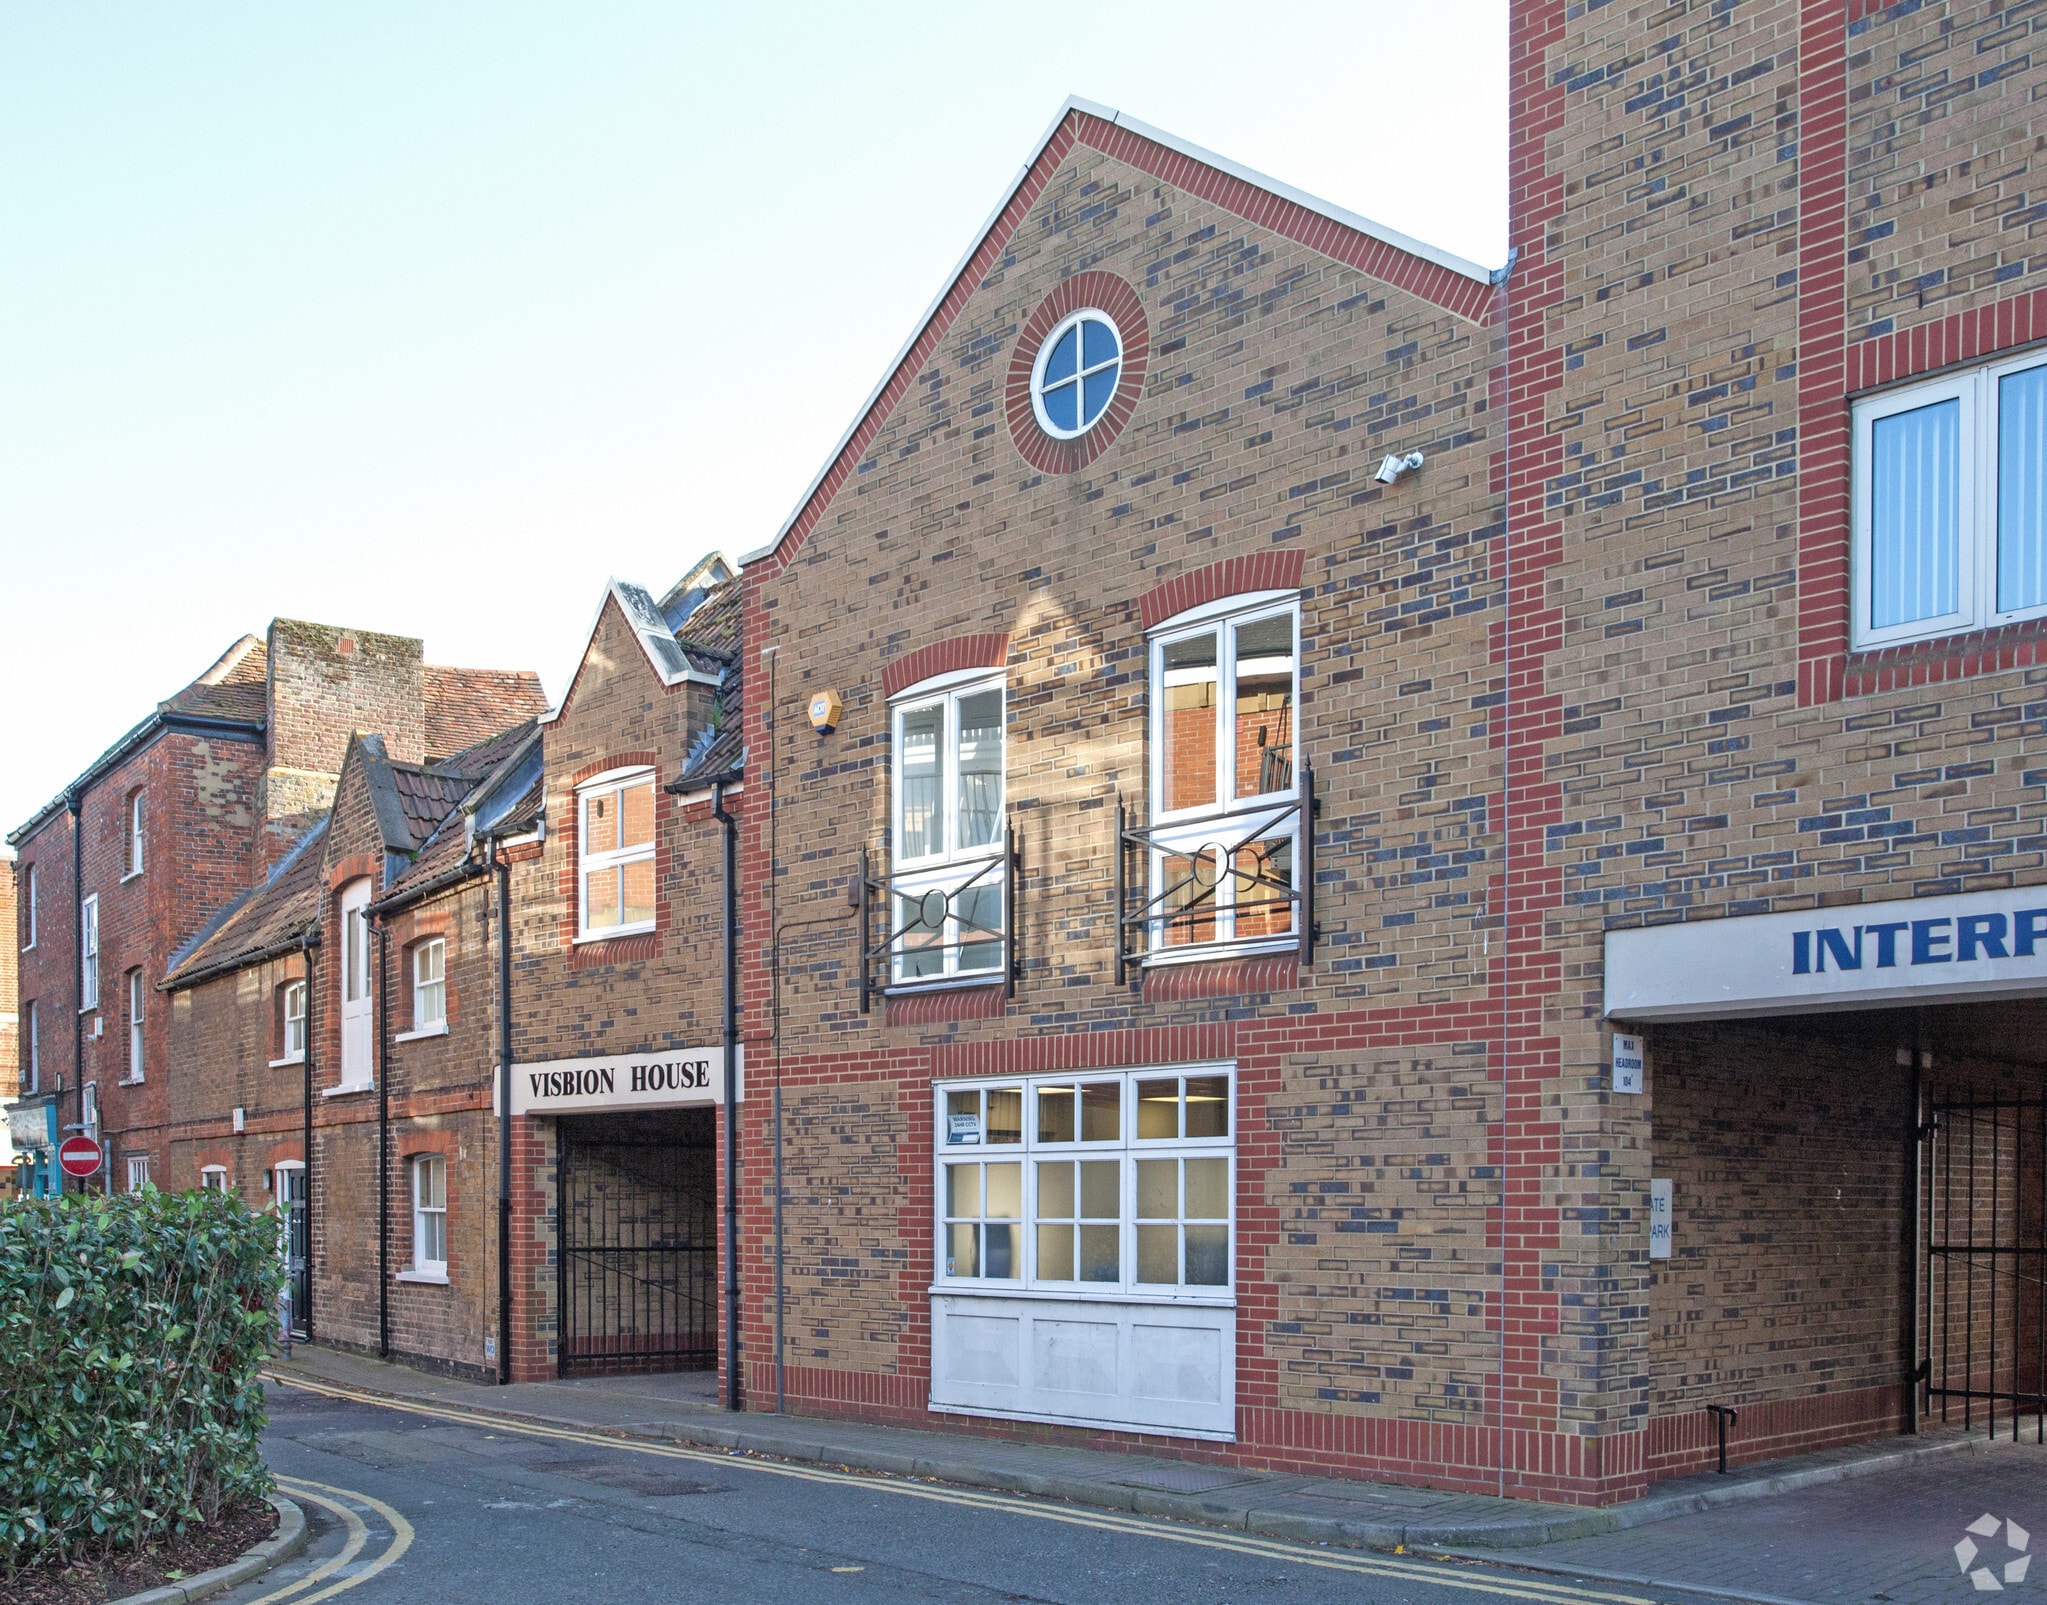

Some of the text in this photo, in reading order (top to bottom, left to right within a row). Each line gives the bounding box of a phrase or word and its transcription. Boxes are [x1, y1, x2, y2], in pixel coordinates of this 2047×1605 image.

[1791, 908, 2047, 975] INTERP
[1622, 1040, 1635, 1051] MAX
[1615, 1057, 1642, 1070] HEADROOM
[529, 1060, 710, 1098] VISBION HOUSE
[1650, 1224, 1670, 1239] ARK
